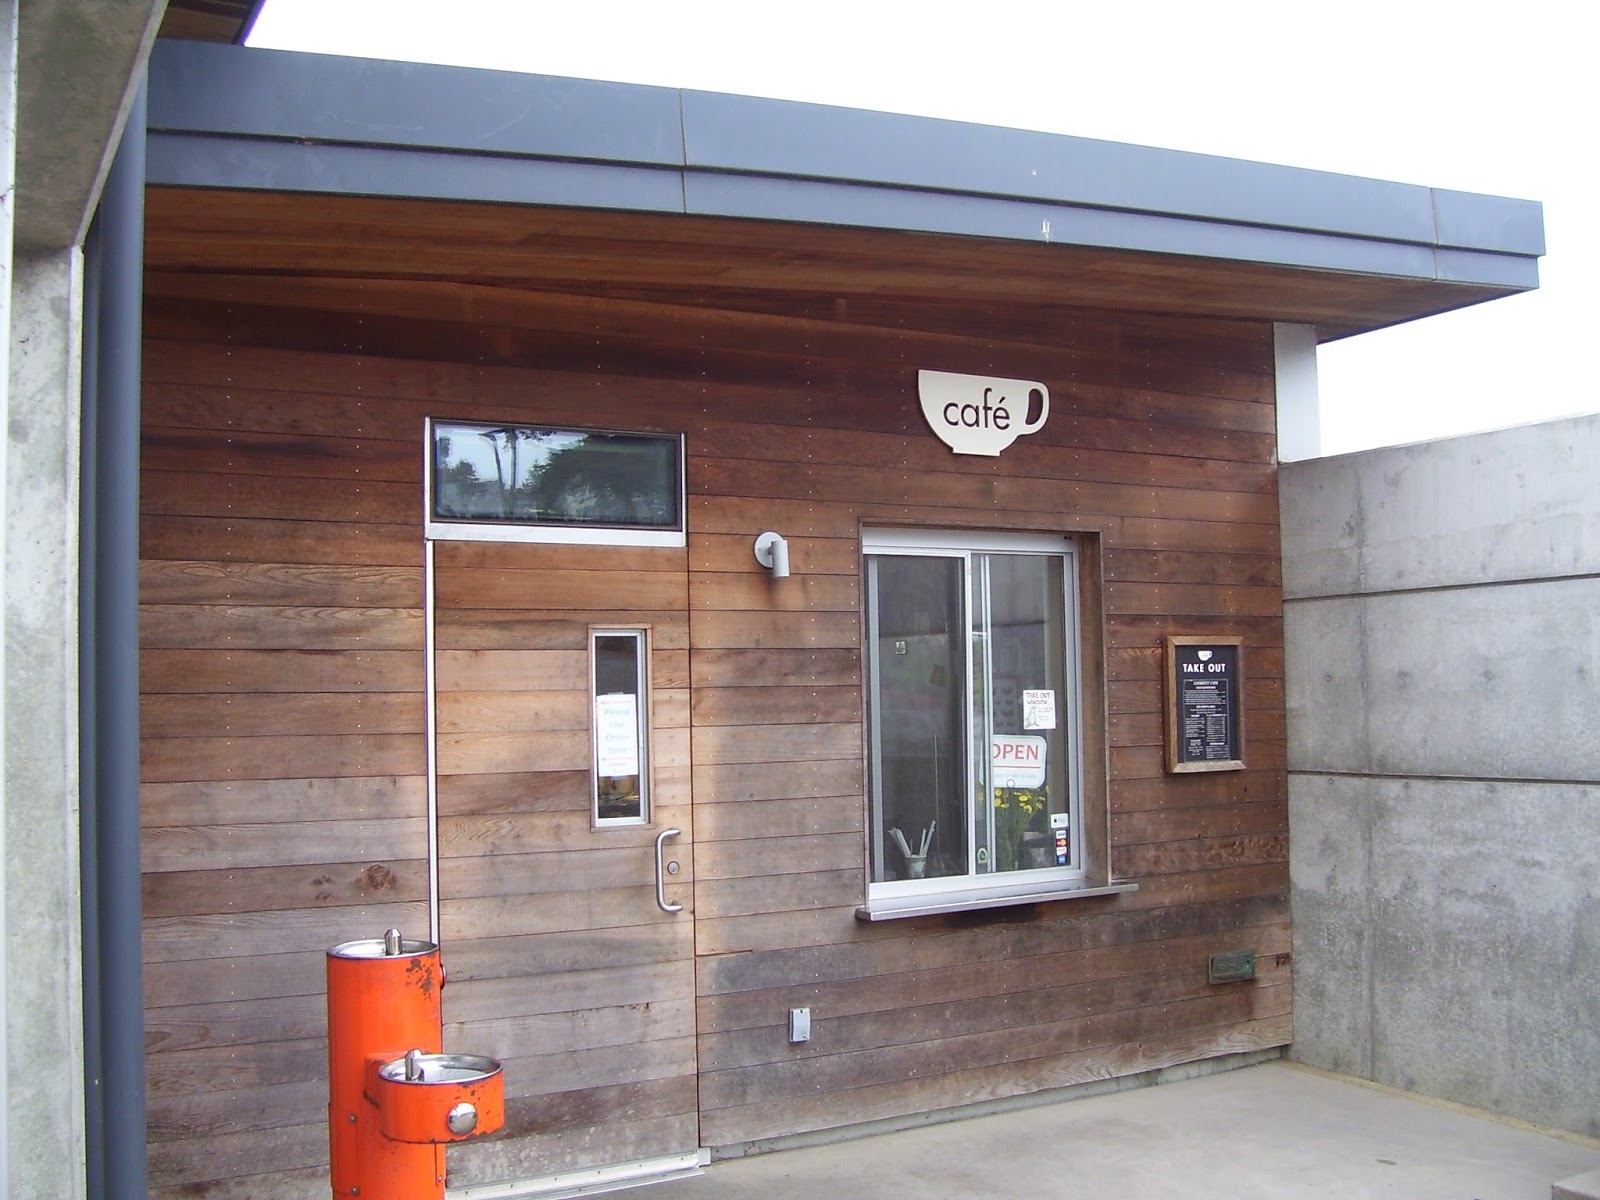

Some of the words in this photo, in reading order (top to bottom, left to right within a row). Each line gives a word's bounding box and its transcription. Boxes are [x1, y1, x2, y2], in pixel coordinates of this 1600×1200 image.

[943, 387, 1010, 430] café
[1182, 663, 1205, 673] TAKE
[1207, 663, 1226, 673] OUT
